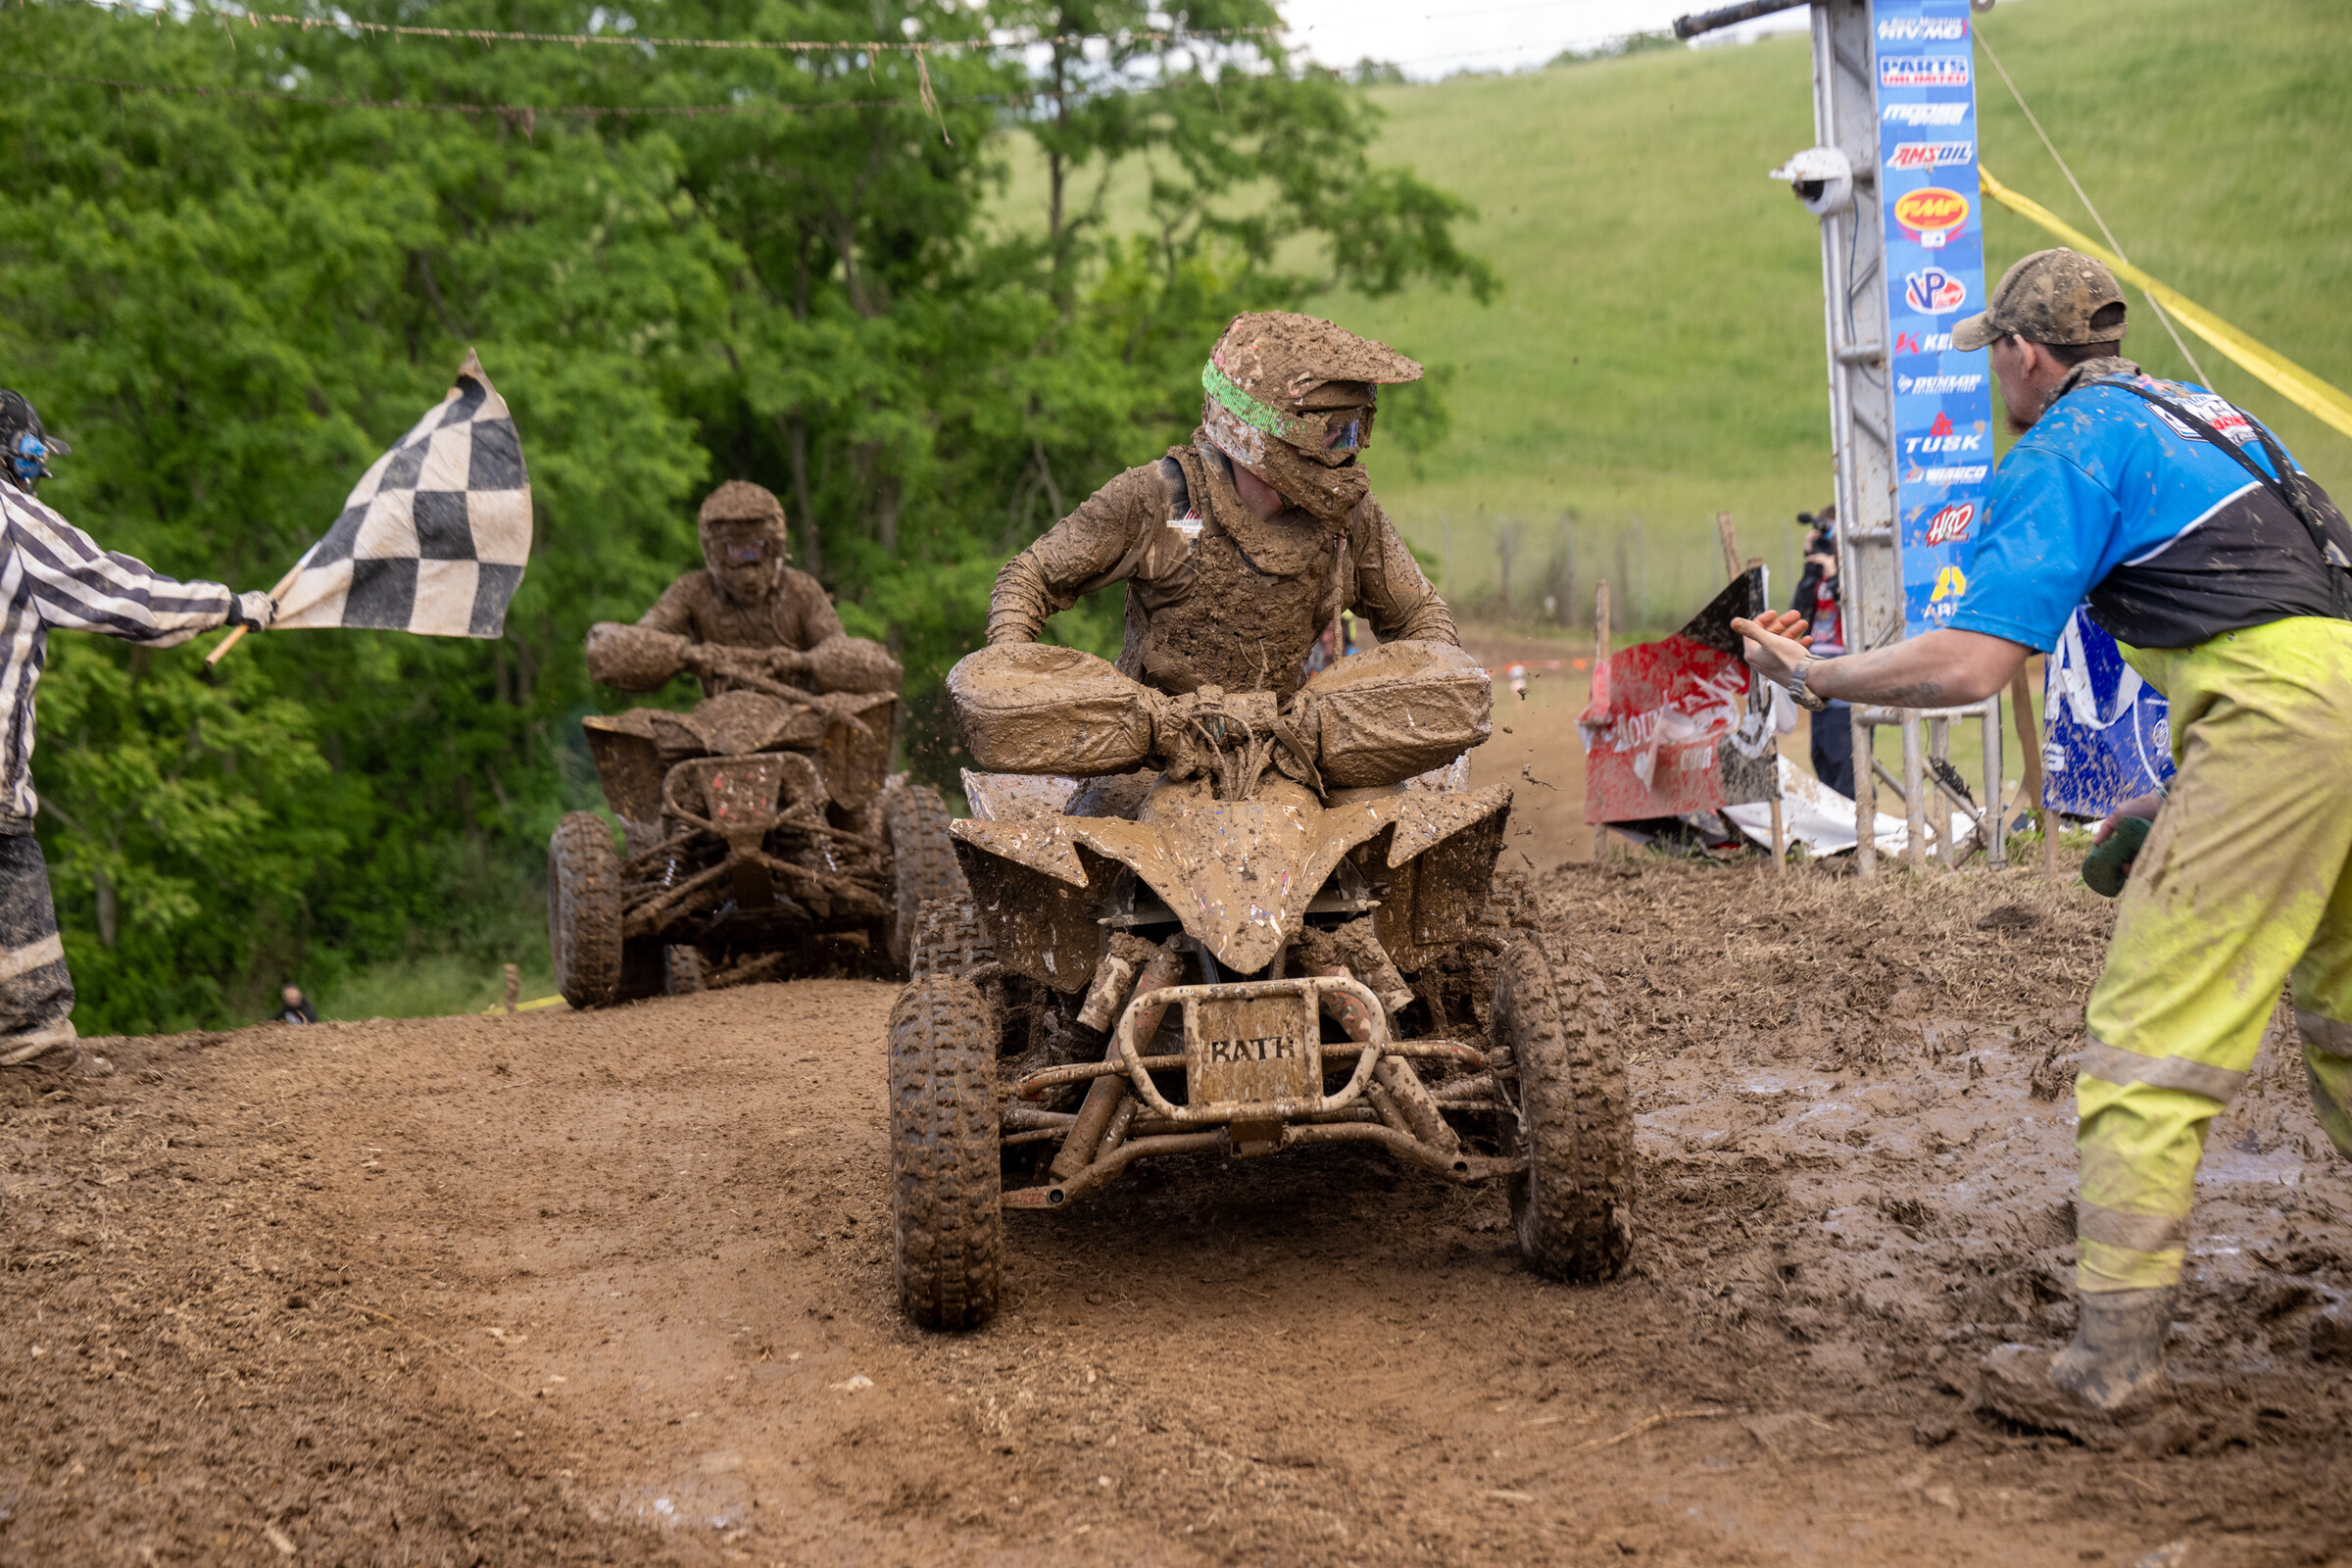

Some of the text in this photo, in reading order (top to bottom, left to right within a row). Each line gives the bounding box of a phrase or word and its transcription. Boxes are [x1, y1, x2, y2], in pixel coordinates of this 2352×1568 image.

[1892, 147, 1969, 166] AMSOIL
[1900, 198, 1962, 218] FMF
[1909, 272, 1946, 310] VP
[1914, 374, 1982, 389] DUNLOP
[1905, 435, 1984, 454] TUSK
[1211, 1037, 1296, 1062] RATH
